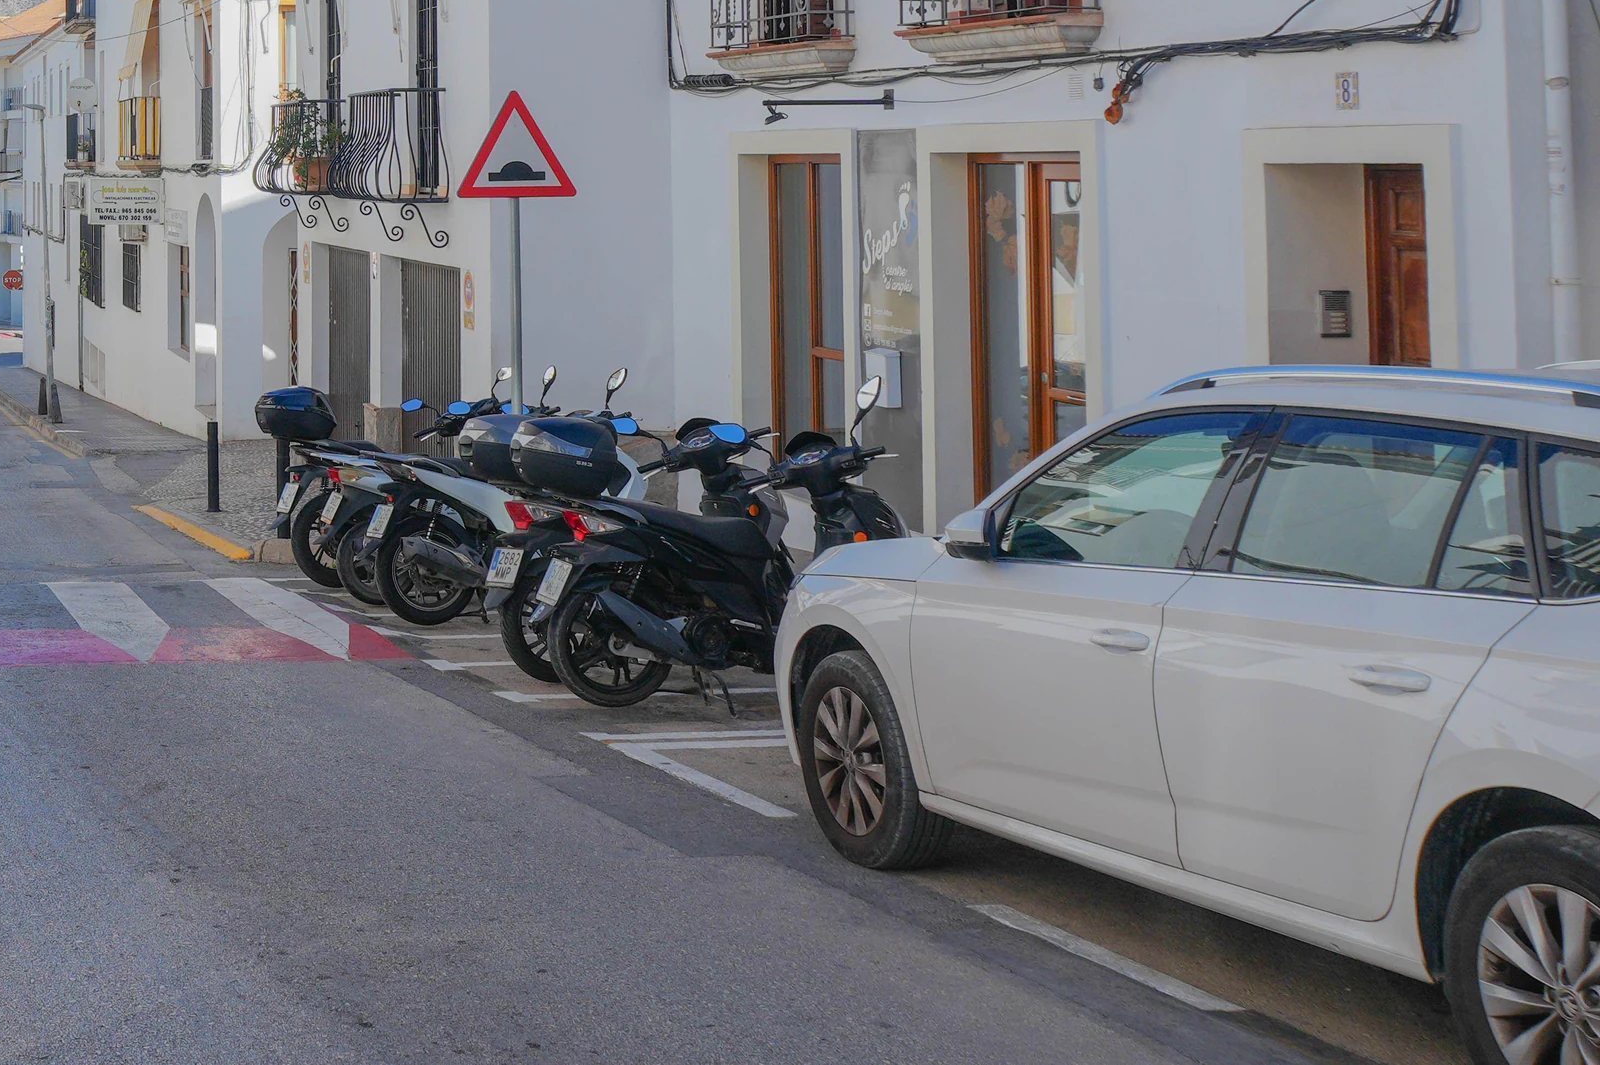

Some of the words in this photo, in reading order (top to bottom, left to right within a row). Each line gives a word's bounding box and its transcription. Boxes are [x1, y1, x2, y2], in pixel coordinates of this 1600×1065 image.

[1341, 79, 1351, 103] 8
[862, 221, 901, 274] Steps
[498, 551, 521, 566] 2682
